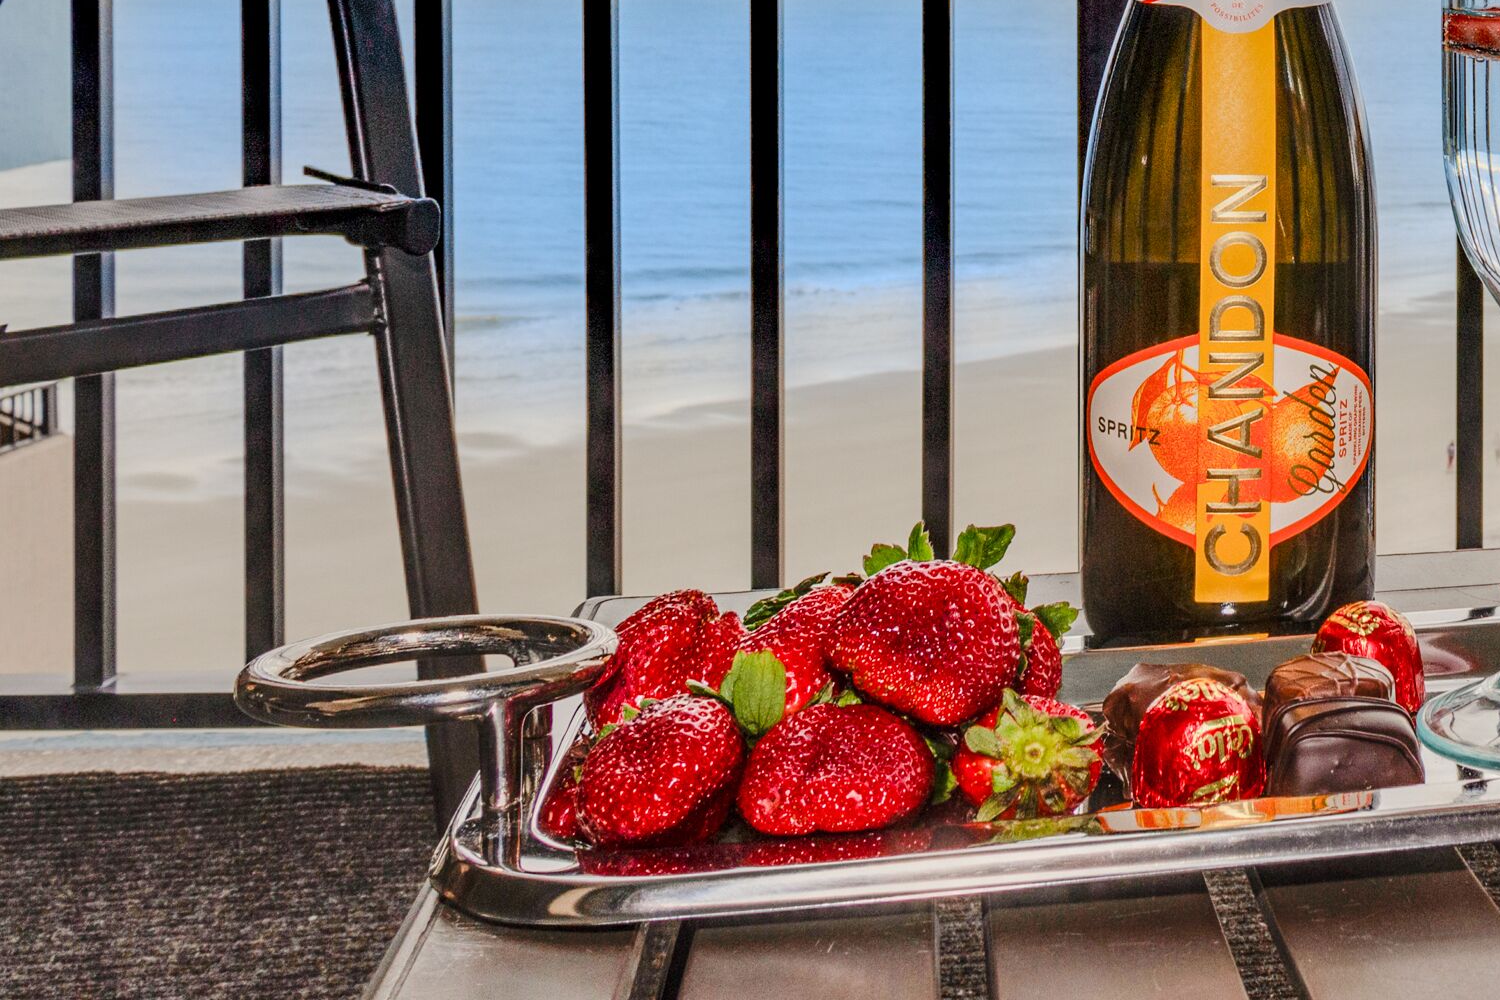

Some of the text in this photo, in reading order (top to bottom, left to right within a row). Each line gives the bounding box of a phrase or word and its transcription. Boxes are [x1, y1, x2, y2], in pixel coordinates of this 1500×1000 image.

[1204, 174, 1267, 577] CHANDON
[1098, 416, 1161, 446] SPRITZ
[1283, 362, 1347, 495] Garden
[1339, 399, 1348, 458] SPRITZ
